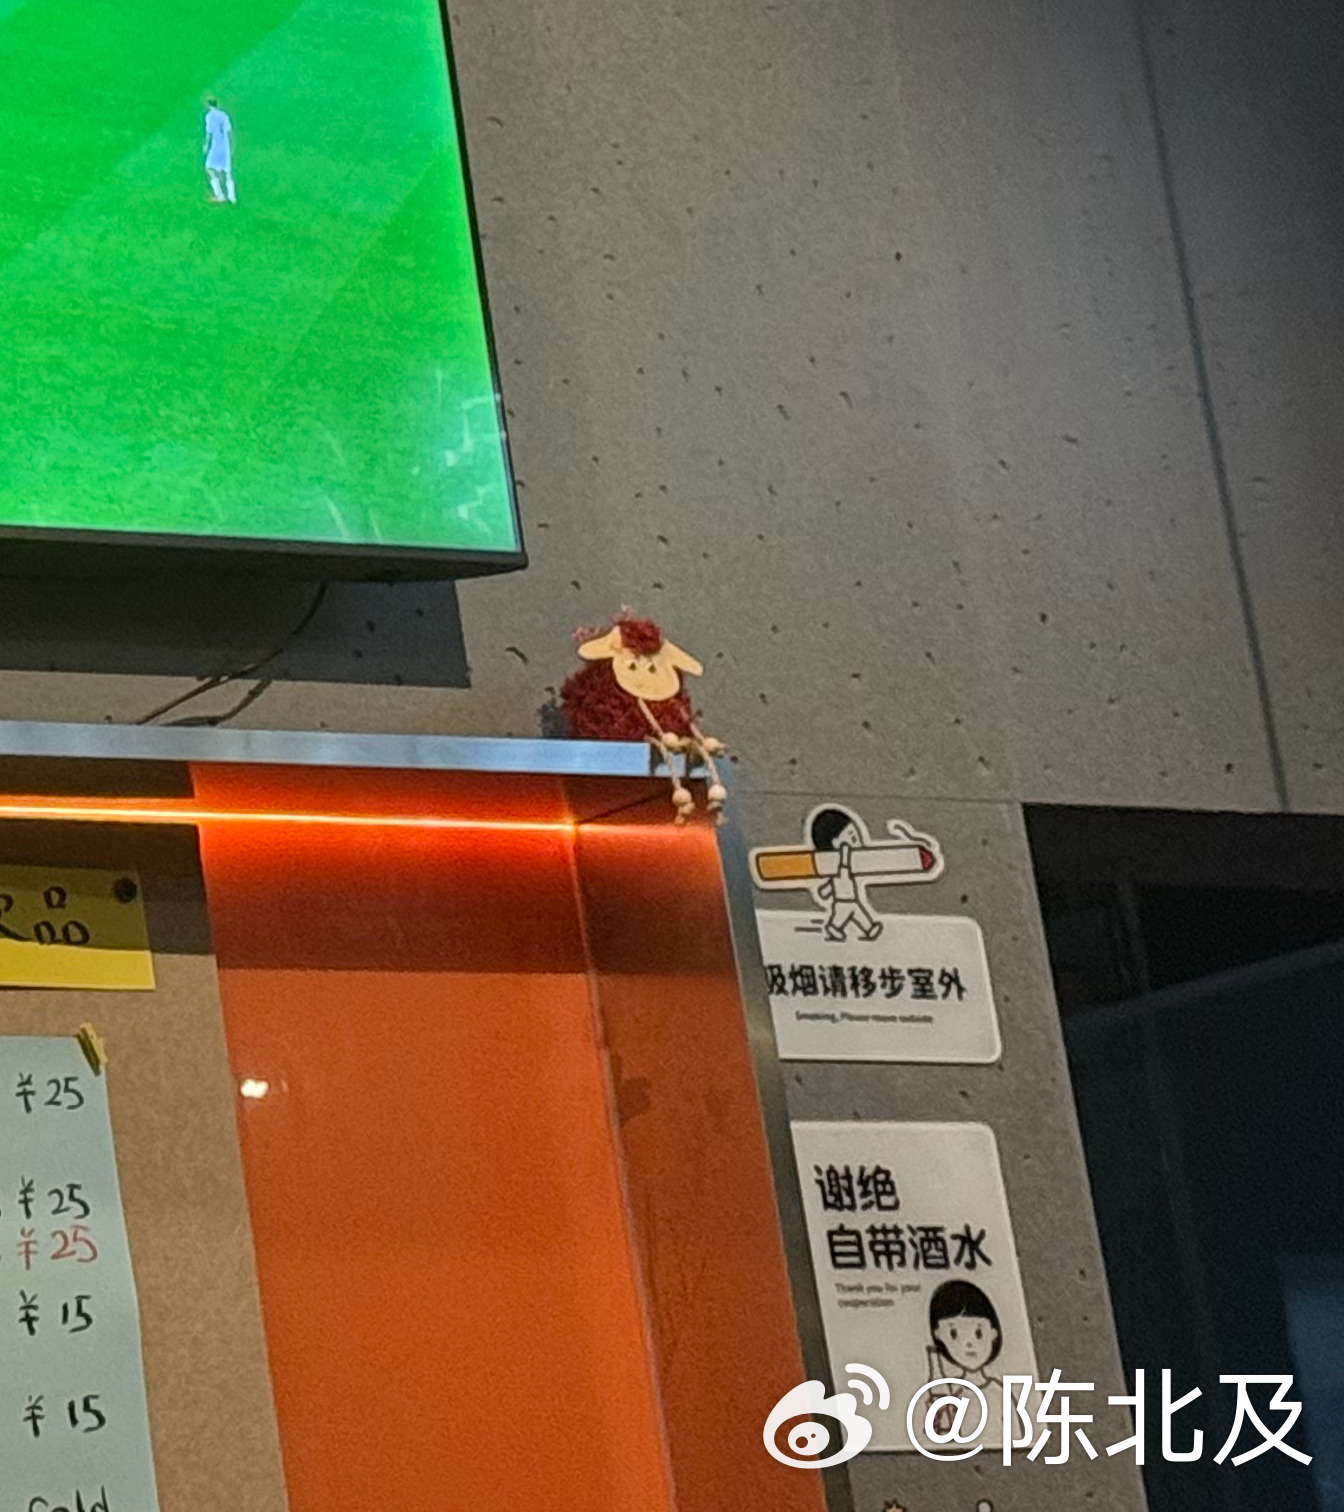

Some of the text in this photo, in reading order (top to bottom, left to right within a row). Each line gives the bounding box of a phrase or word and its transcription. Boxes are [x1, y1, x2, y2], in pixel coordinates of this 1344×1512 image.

[813, 1164, 900, 1212] 谢绝
[827, 1223, 993, 1271] 自带酒水
